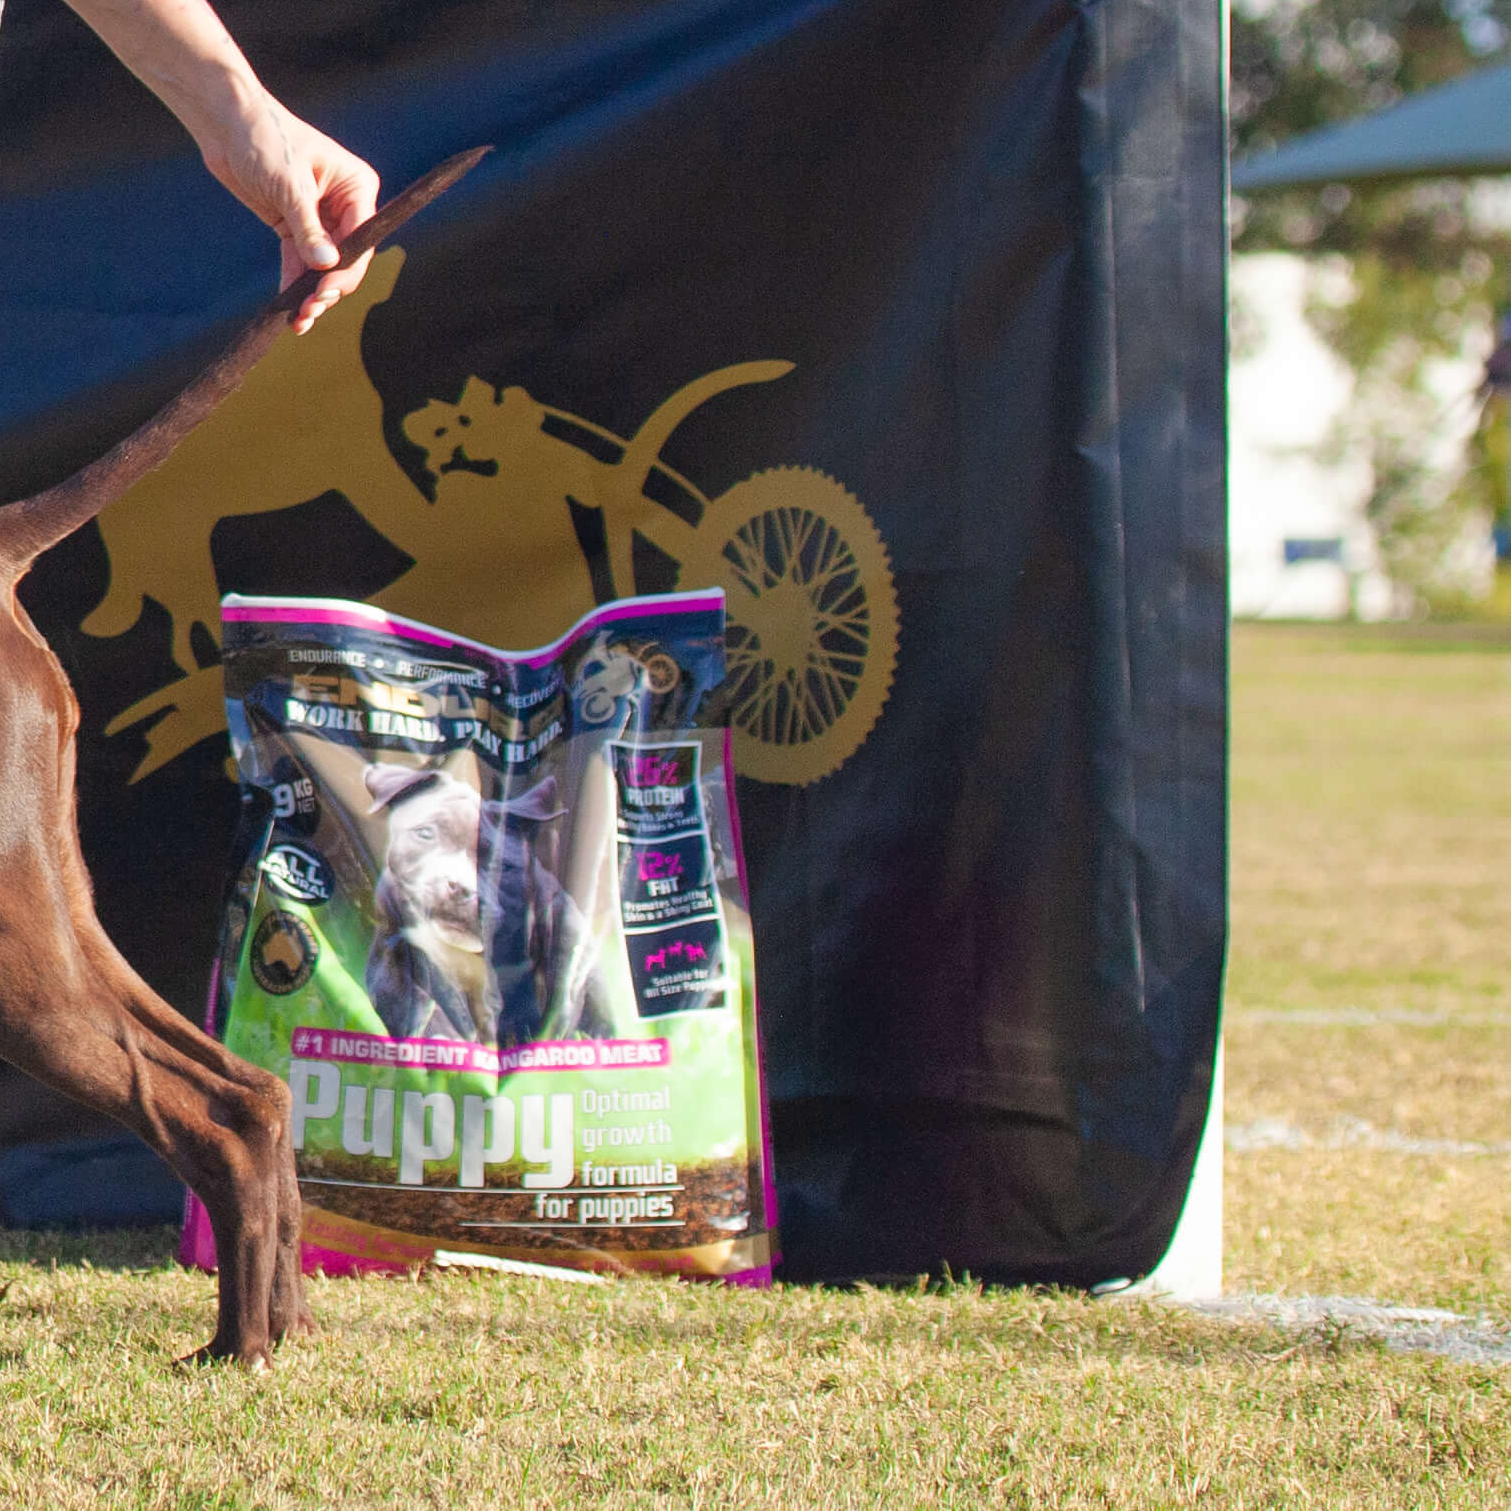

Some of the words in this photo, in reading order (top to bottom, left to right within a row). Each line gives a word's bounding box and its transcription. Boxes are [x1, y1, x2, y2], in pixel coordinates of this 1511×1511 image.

[288, 649, 367, 669] ENDURANCE
[395, 660, 488, 689] PERFORMANCE
[284, 698, 363, 732] WORK
[369, 710, 447, 742] HARD.
[454, 720, 502, 756] PLAY
[273, 783, 296, 818] 9
[294, 777, 314, 798] KG
[635, 852, 685, 882] 12%
[647, 876, 680, 898] FAT
[295, 1034, 324, 1054] #1
[330, 1037, 471, 1067] INGREDIENT
[473, 1046, 595, 1072] KANGAROO
[598, 1042, 665, 1066] MEAT
[290, 1059, 575, 1188] Puppy
[582, 1085, 671, 1116] Optimal
[582, 1117, 673, 1151] growth
[581, 1160, 678, 1186] formula
[535, 1193, 575, 1219] for
[579, 1191, 674, 1225] puppies
